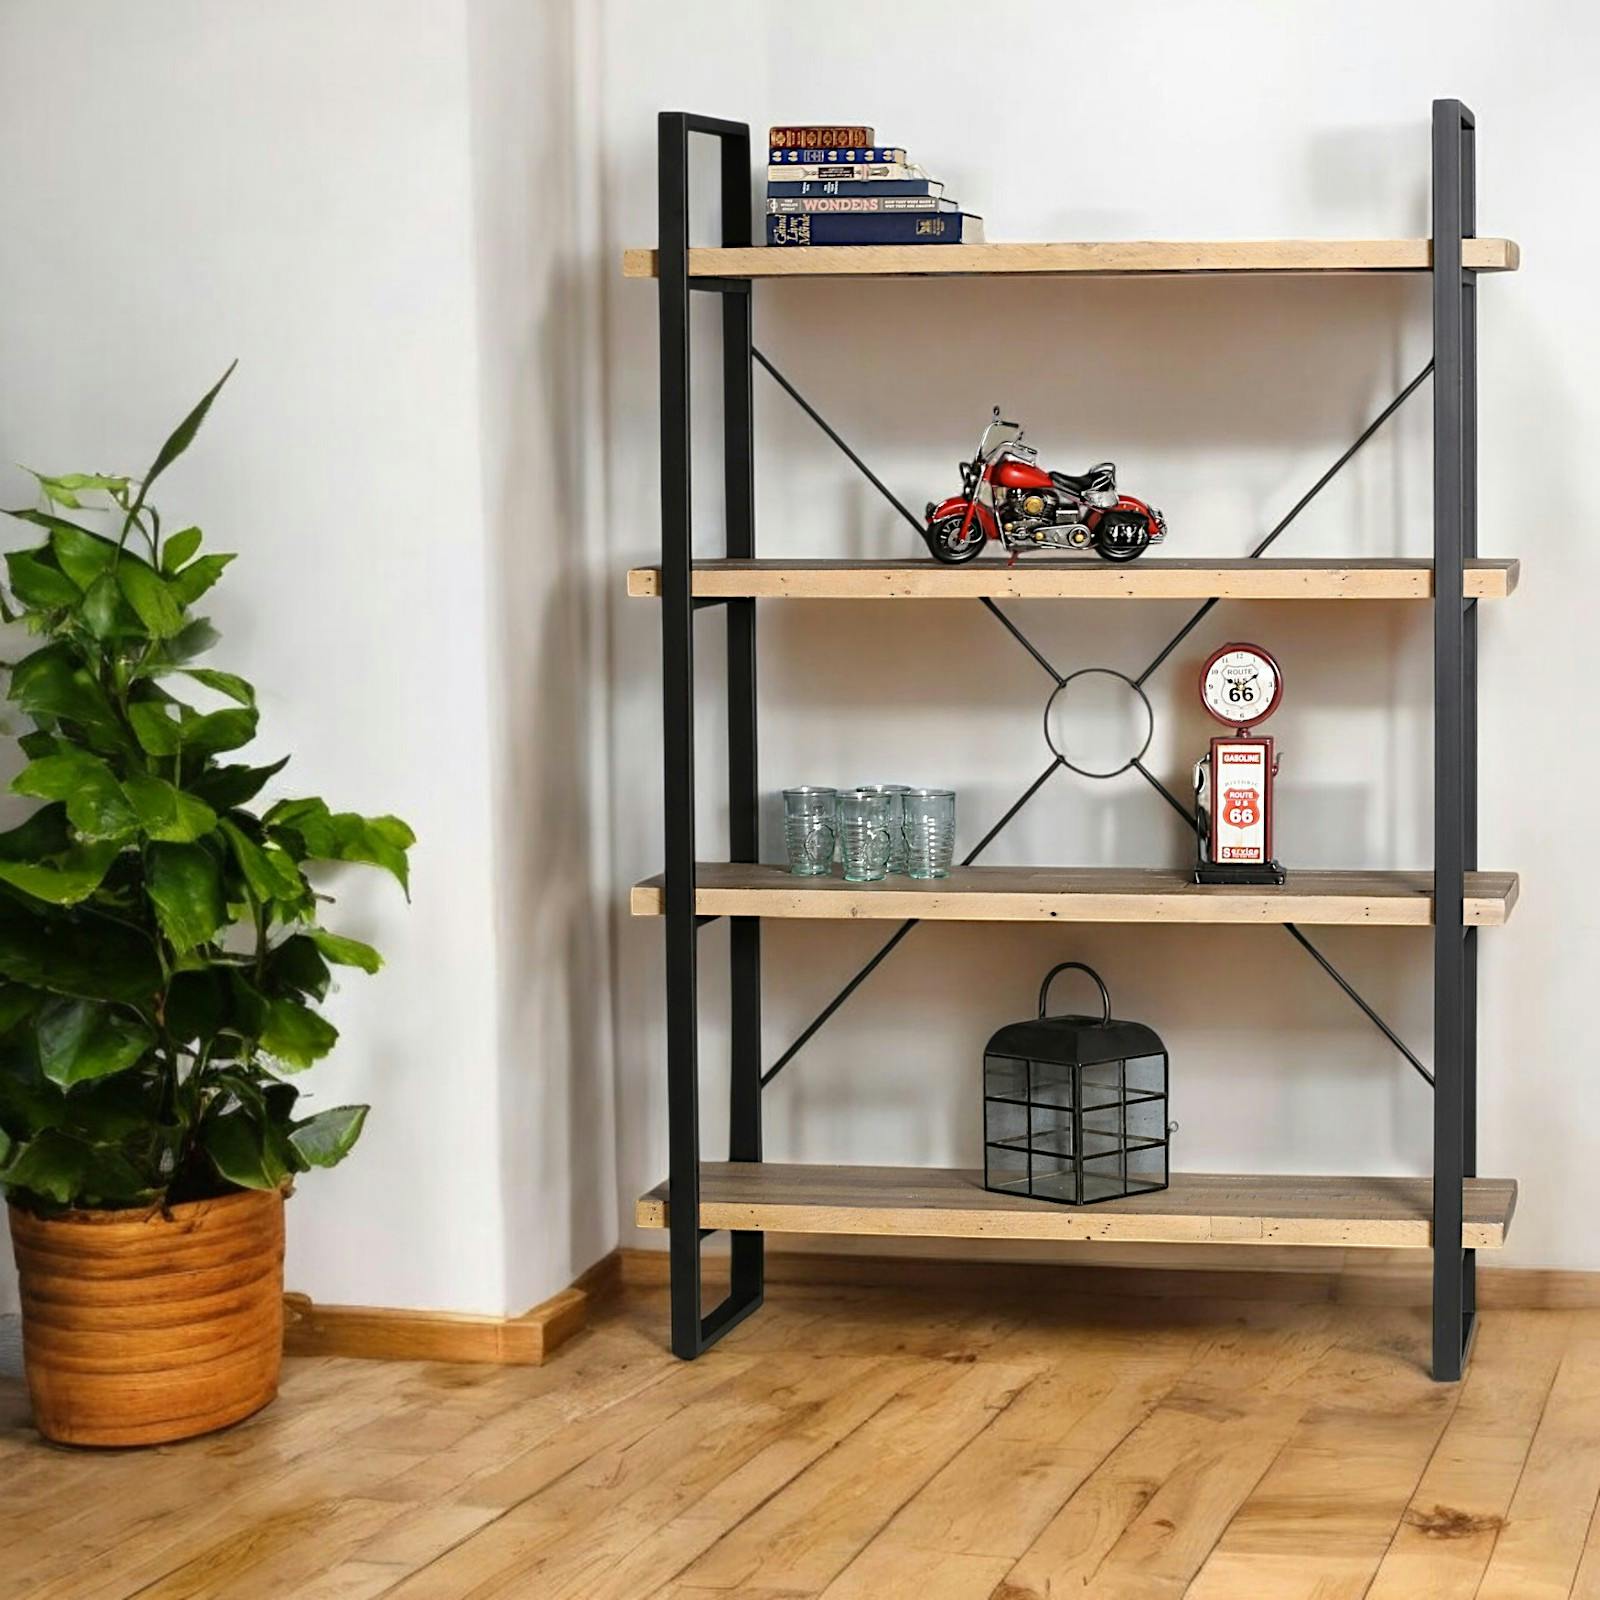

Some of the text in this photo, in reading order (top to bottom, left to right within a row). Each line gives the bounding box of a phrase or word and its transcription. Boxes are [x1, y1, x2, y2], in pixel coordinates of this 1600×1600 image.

[803, 199, 878, 211] WONDERS
[1229, 687, 1254, 702] 66
[1223, 754, 1260, 763] GASOLINE
[1229, 791, 1254, 799] ROUTE
[1229, 808, 1254, 824] 66
